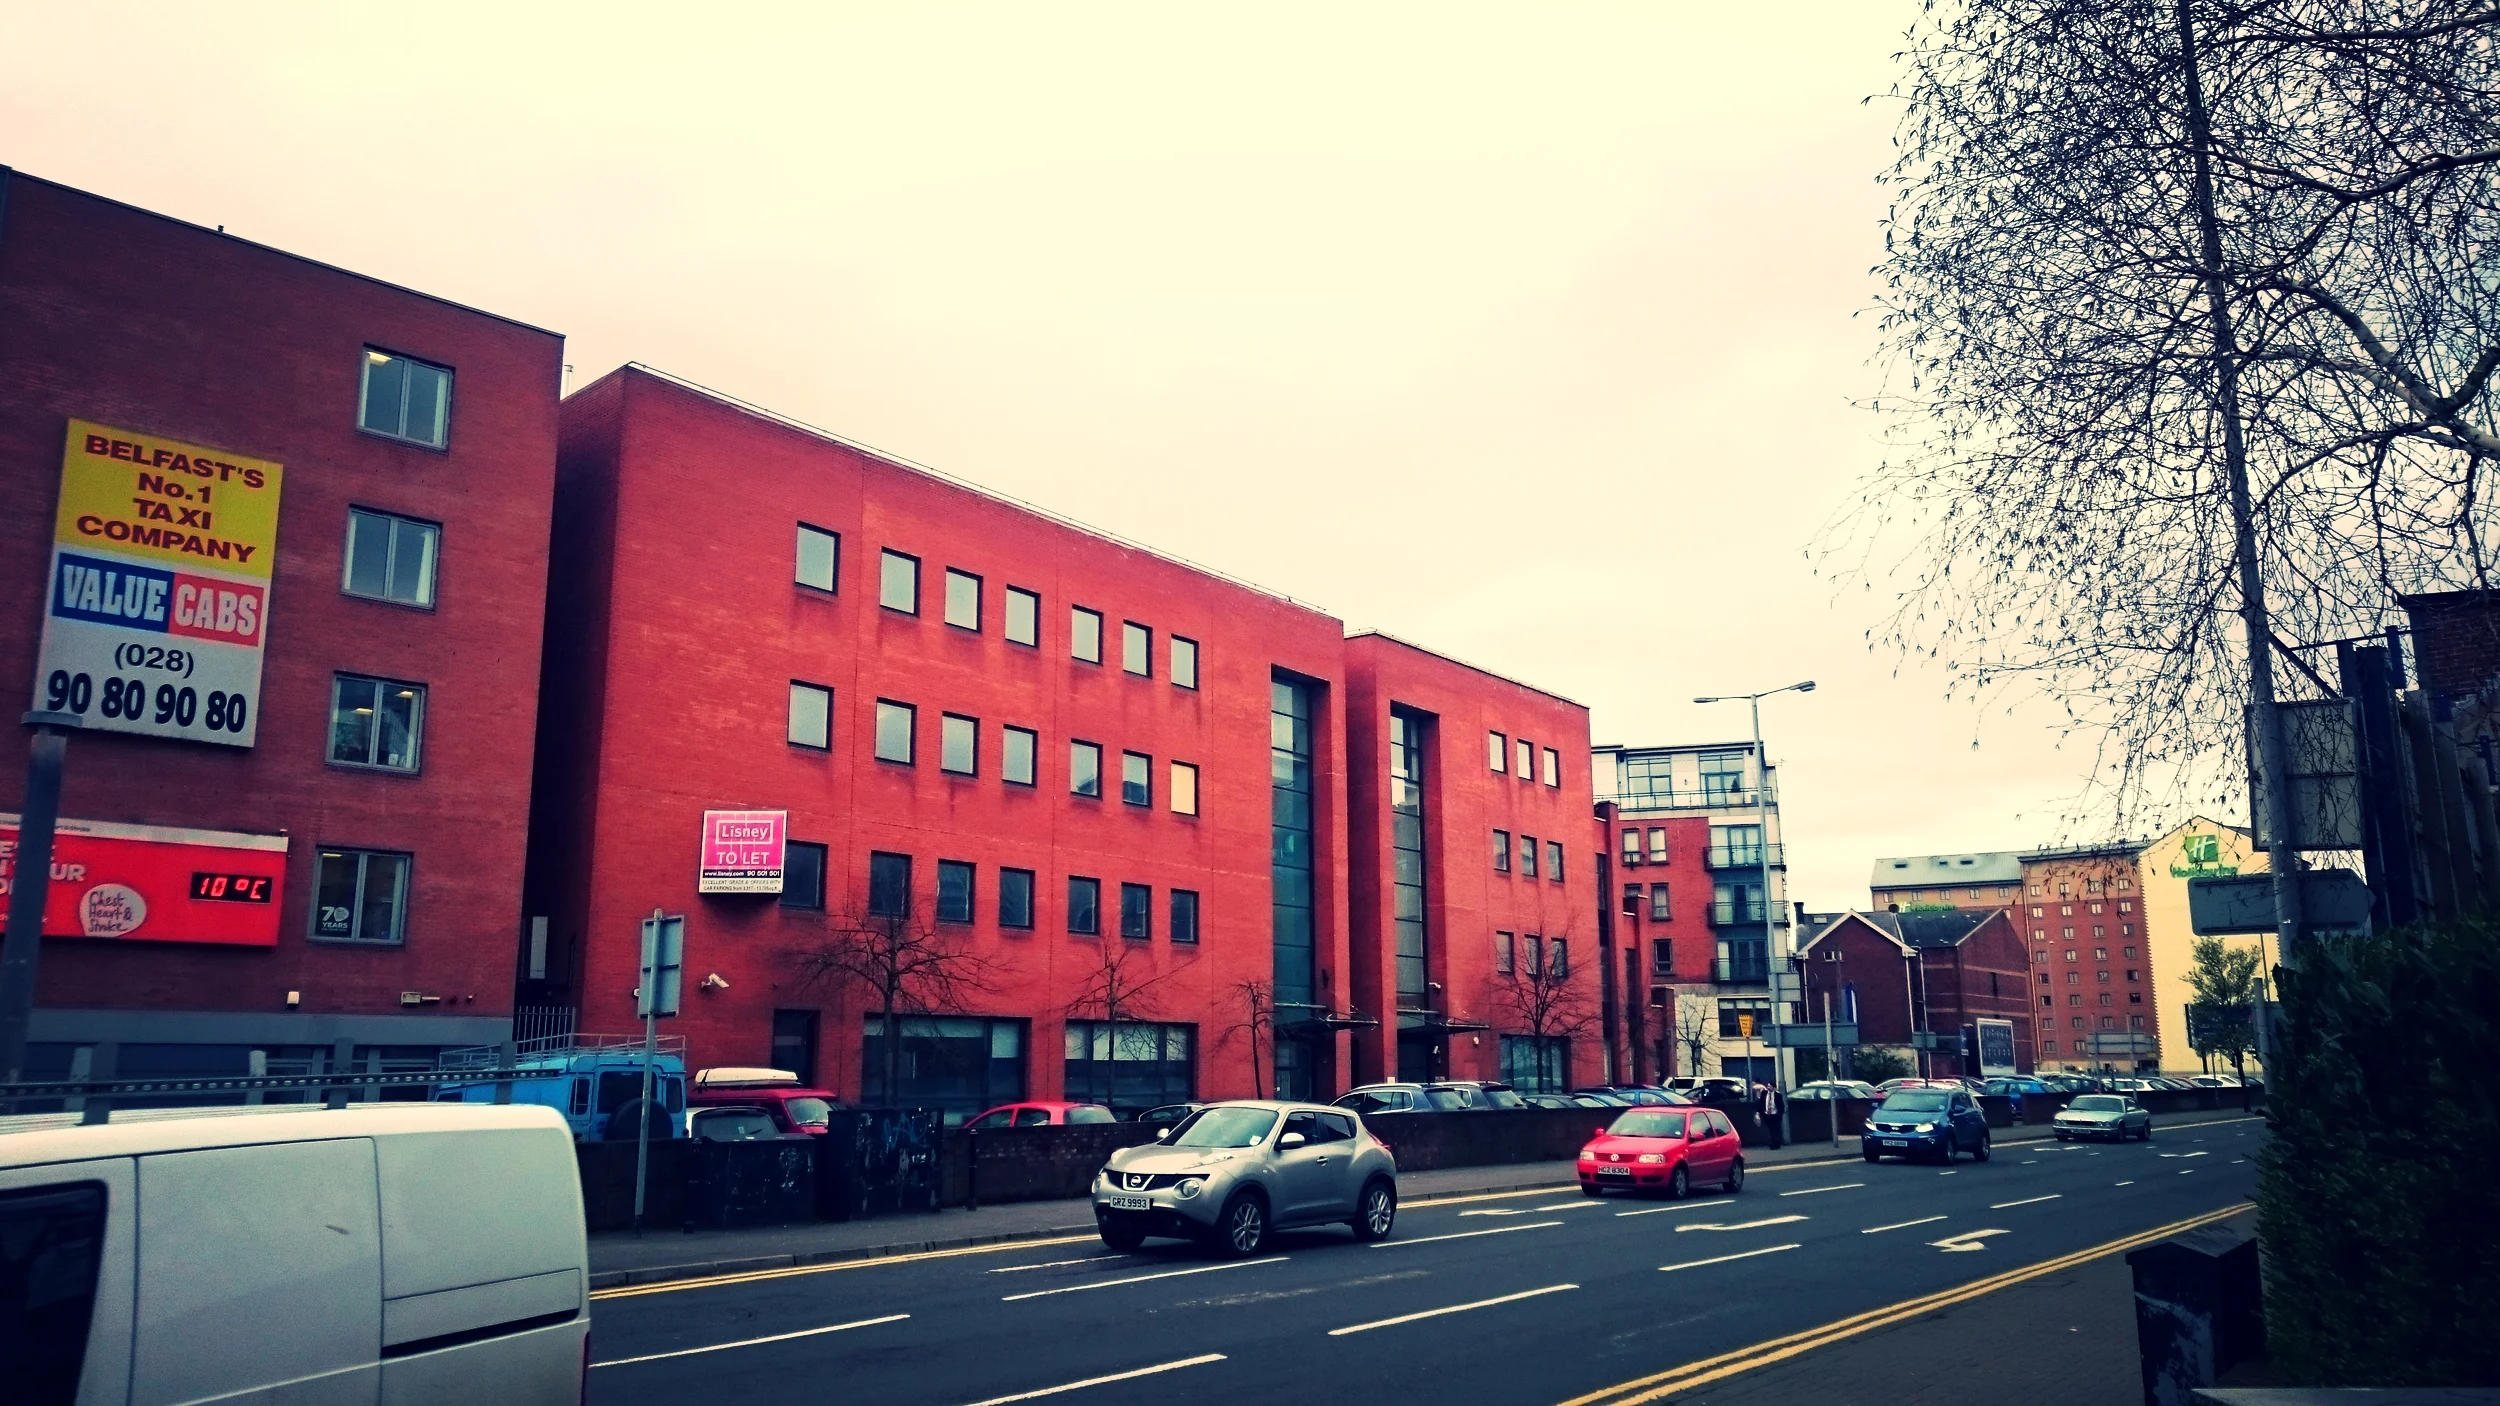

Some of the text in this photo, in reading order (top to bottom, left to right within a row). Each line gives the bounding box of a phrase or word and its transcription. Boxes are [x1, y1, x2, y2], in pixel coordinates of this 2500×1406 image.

[85, 434, 265, 489] BELFAST'S
[138, 473, 212, 504] No.1
[133, 498, 212, 530] TAXI
[76, 515, 257, 564] COMPANY
[63, 564, 259, 636] VALUE CABS
[114, 643, 195, 679] (028)
[48, 670, 247, 733] 90 80 90 80
[721, 825, 769, 839] Lisney
[716, 851, 770, 865] TO LET
[89, 890, 125, 907] Chest
[200, 877, 228, 897] 10
[88, 904, 133, 921] Heart &
[88, 918, 129, 932] Stroke
[1112, 1197, 1147, 1208] GRZ 9993
